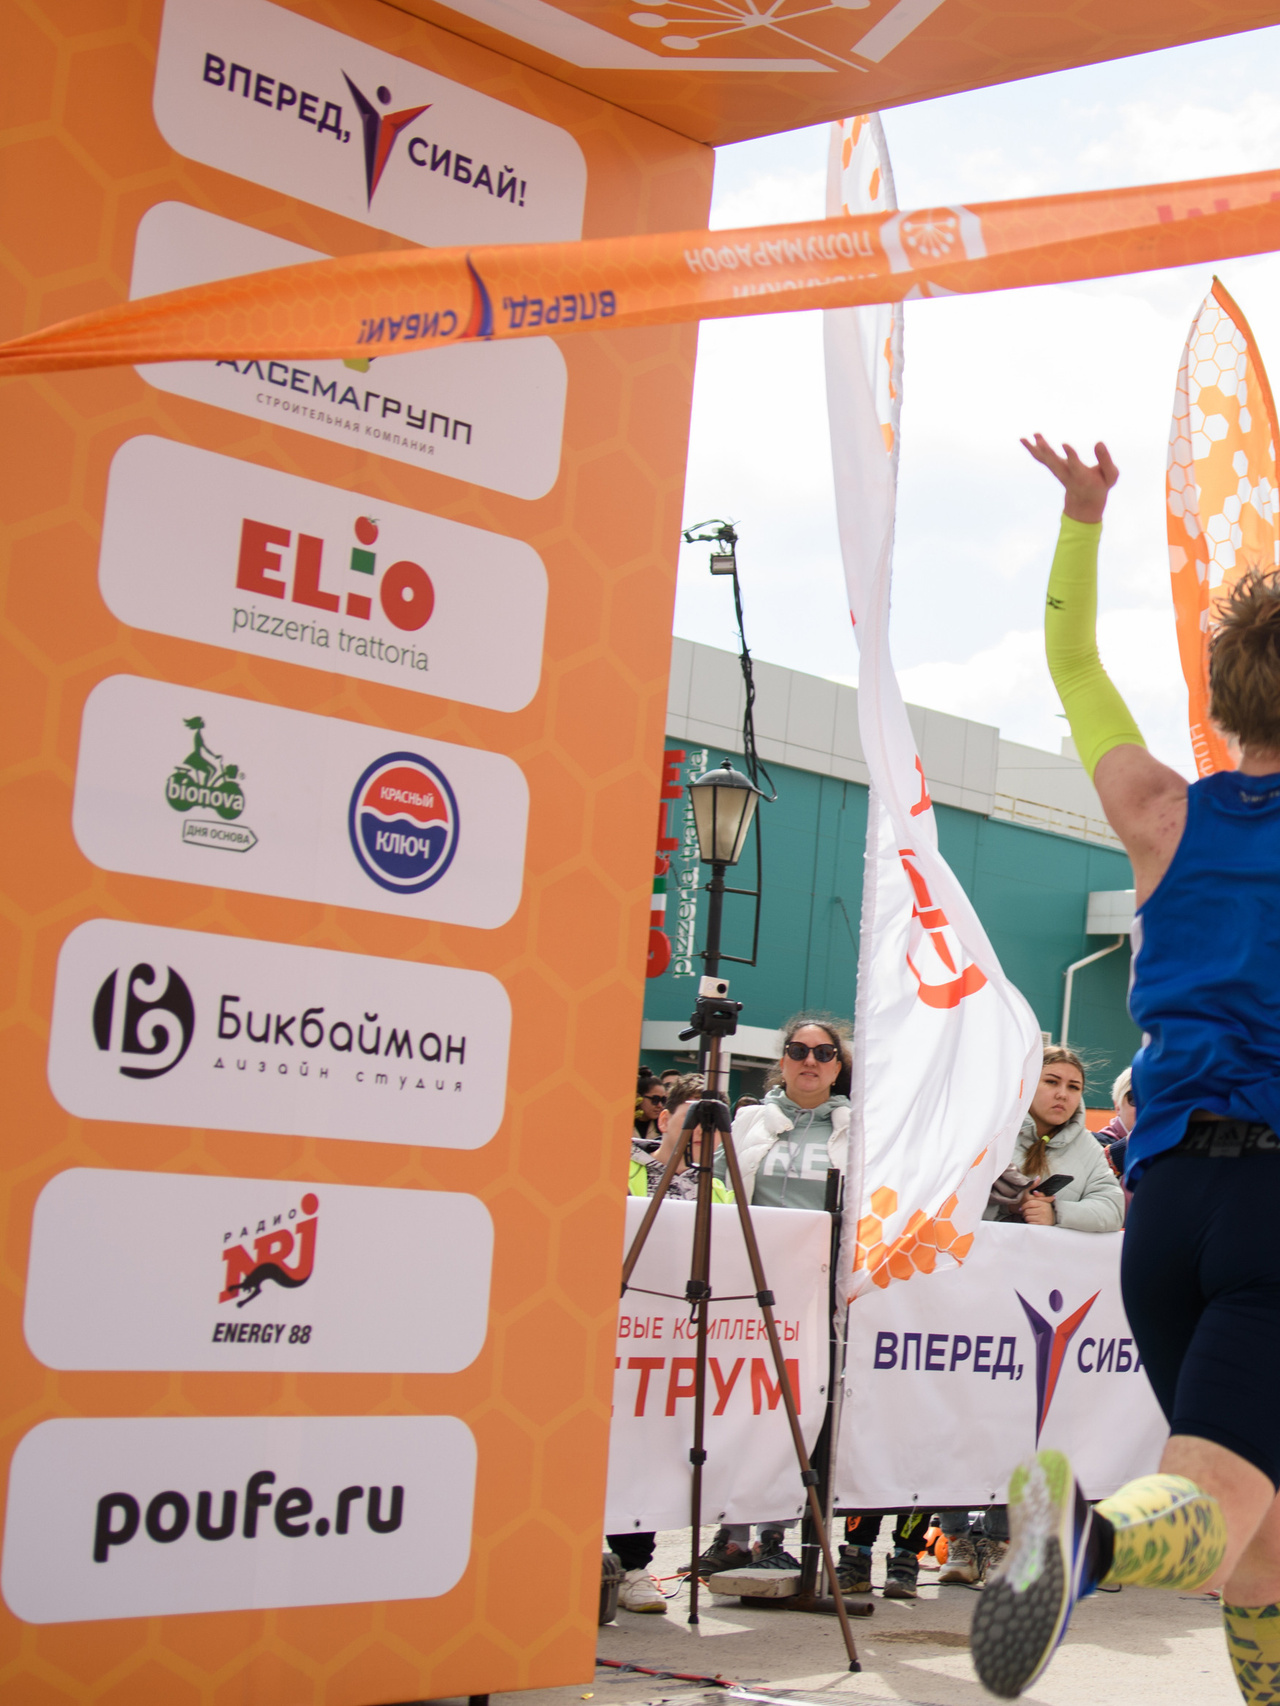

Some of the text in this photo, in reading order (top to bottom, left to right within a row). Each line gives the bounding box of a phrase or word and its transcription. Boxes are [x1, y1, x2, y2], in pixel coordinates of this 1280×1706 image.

[203, 53, 526, 207] ВПЕРЕД, СИБАЙ!
[684, 231, 874, 274] ПОЛУМАРАФОН
[502, 290, 616, 329] ВПЕРЕД,
[256, 392, 435, 455] СТРОИТЕЛЬНАЯ КОМПАНИЯ
[232, 605, 429, 672] pizzeria trattoria
[380, 786, 434, 808] КРАСНЫЙ
[186, 825, 250, 844] ДНЯ ОСНОВА
[376, 830, 431, 859] КЛЮЧ
[672, 867, 700, 978] pizzeria
[217, 994, 466, 1065] Бикбайман
[213, 1057, 463, 1092] дизайн студия
[763, 1140, 829, 1181] RE
[223, 1209, 297, 1243] РАДИО
[212, 1322, 312, 1344] ENERGY 88
[873, 1331, 1147, 1381] ВПЕРЕД, СИБ
[612, 1356, 801, 1418] ТРУМ
[93, 1470, 404, 1563] poufe.ru
